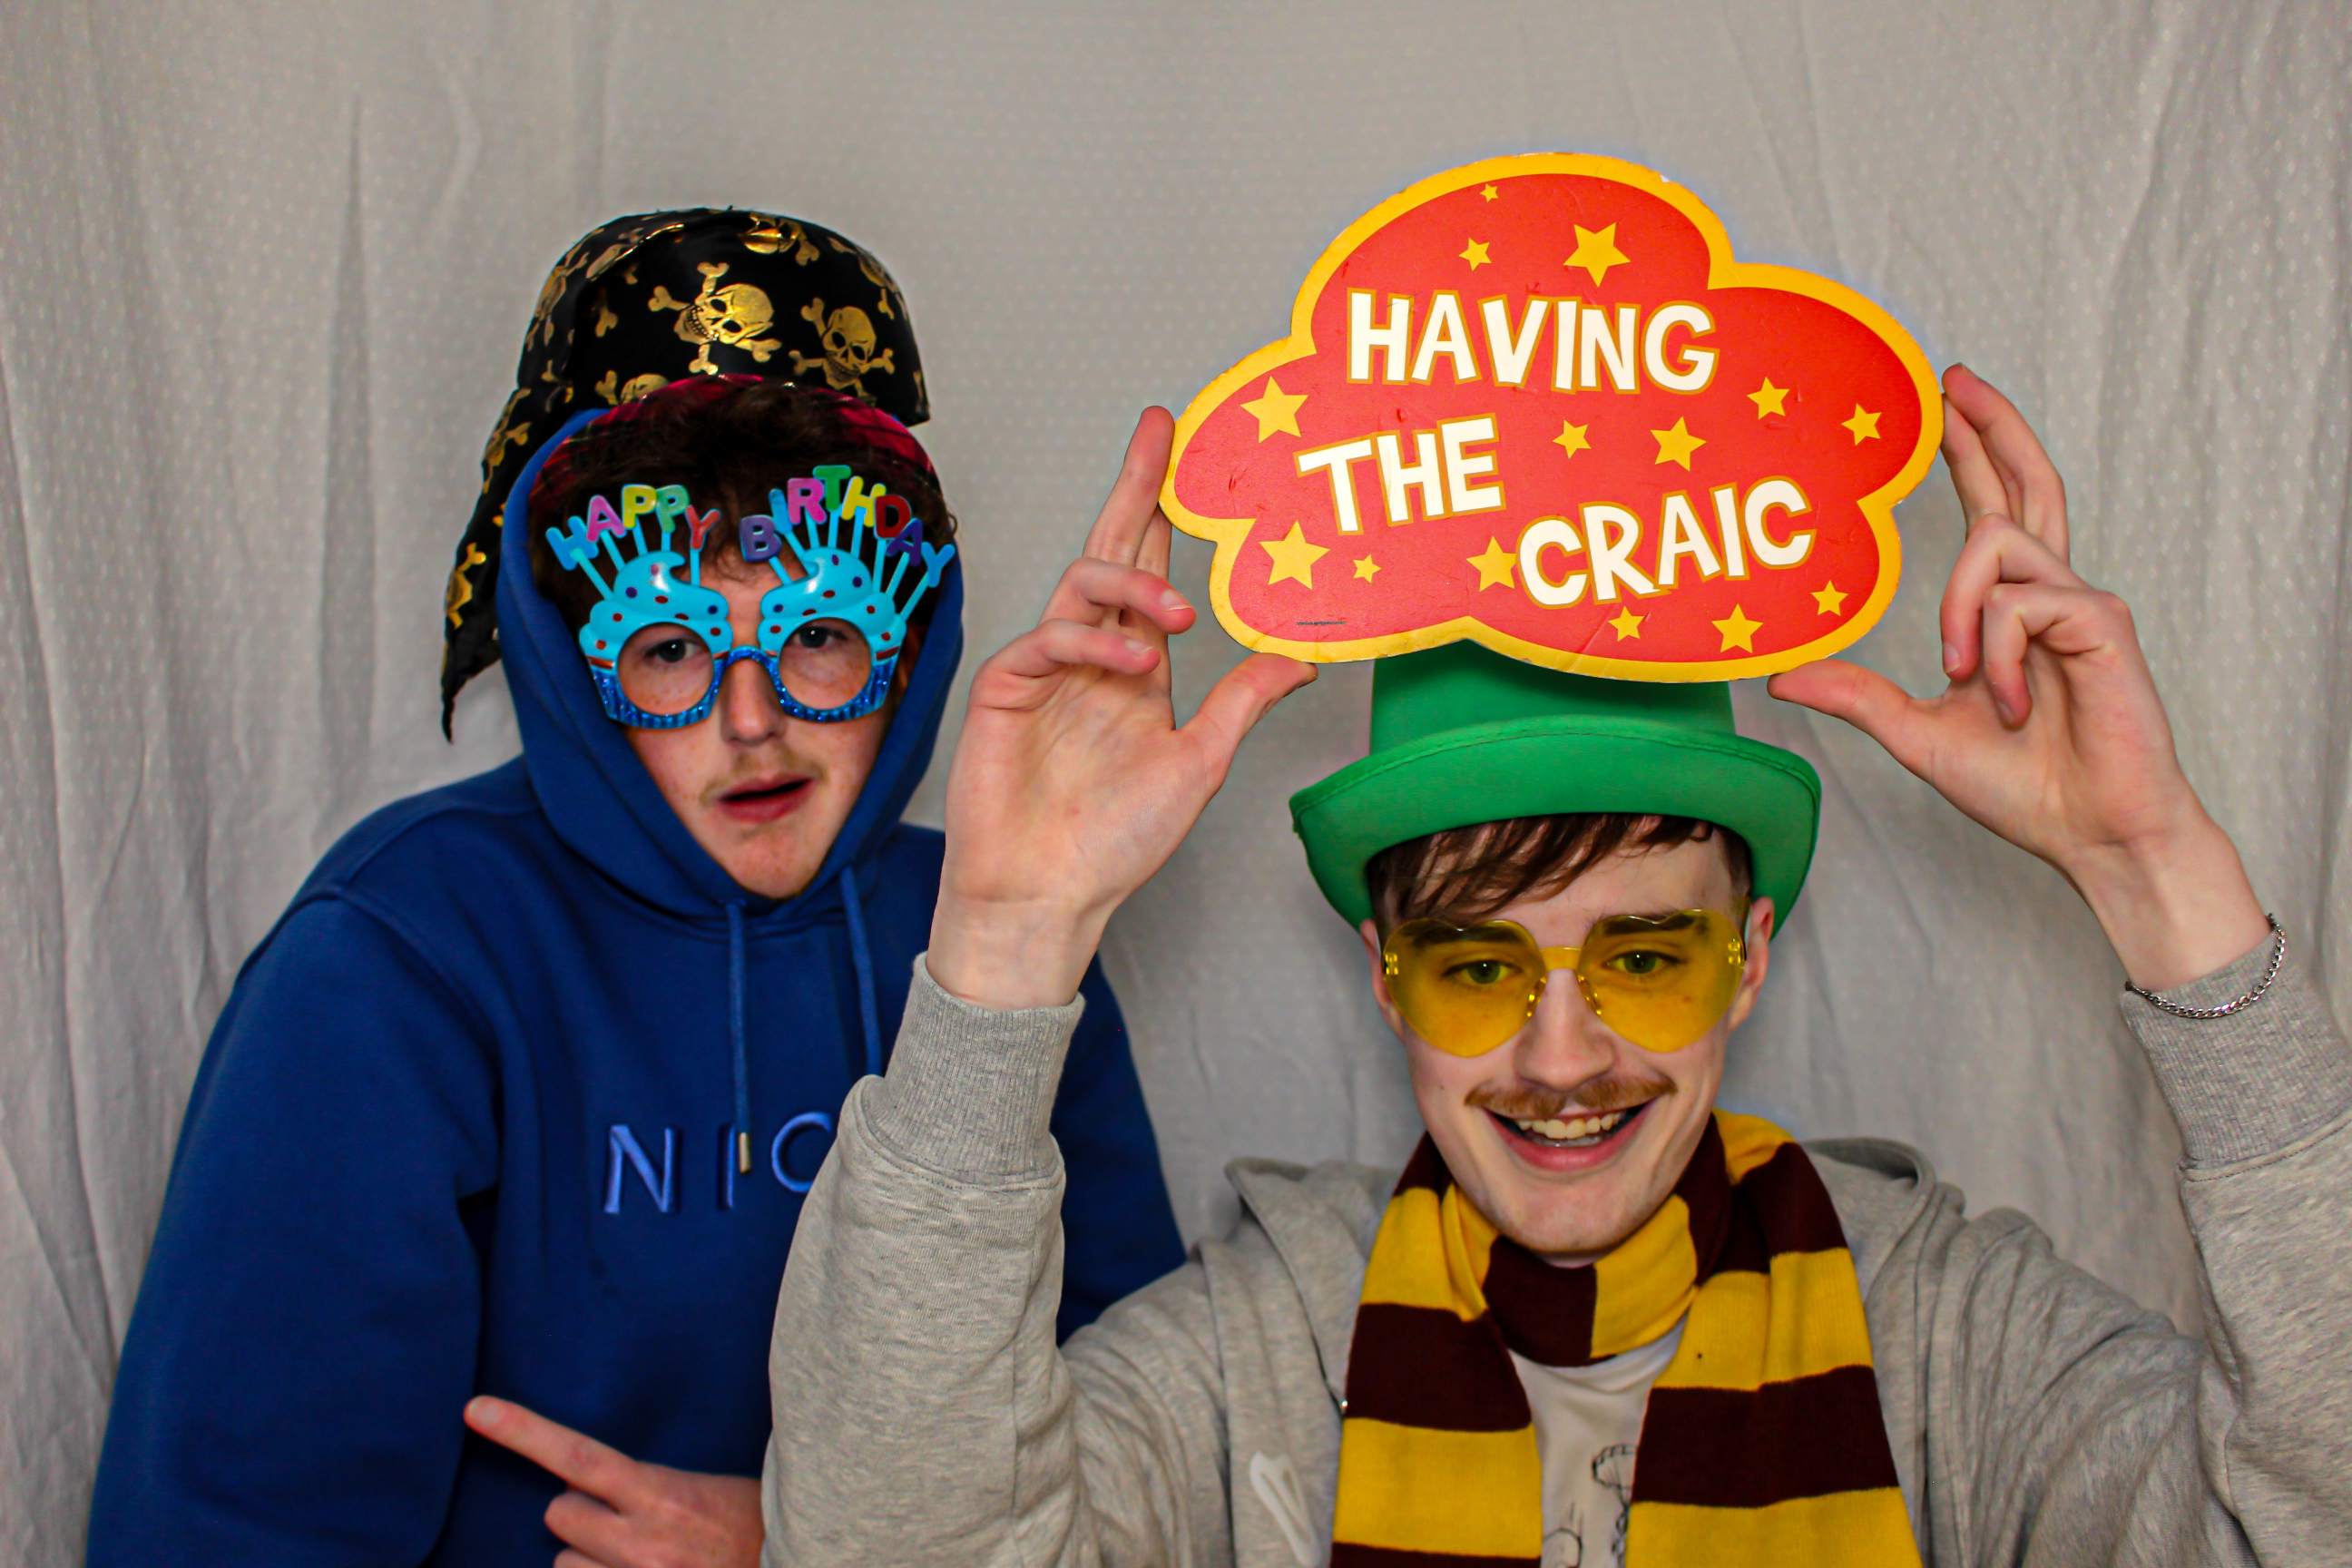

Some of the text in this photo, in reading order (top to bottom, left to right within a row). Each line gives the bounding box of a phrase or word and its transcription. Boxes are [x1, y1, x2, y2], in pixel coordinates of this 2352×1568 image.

[1349, 290, 1717, 392] HAVING
[546, 465, 956, 587] HAPPY BIRTHDAY
[1298, 417, 1503, 534] THE
[1518, 479, 1812, 607] CRAIC
